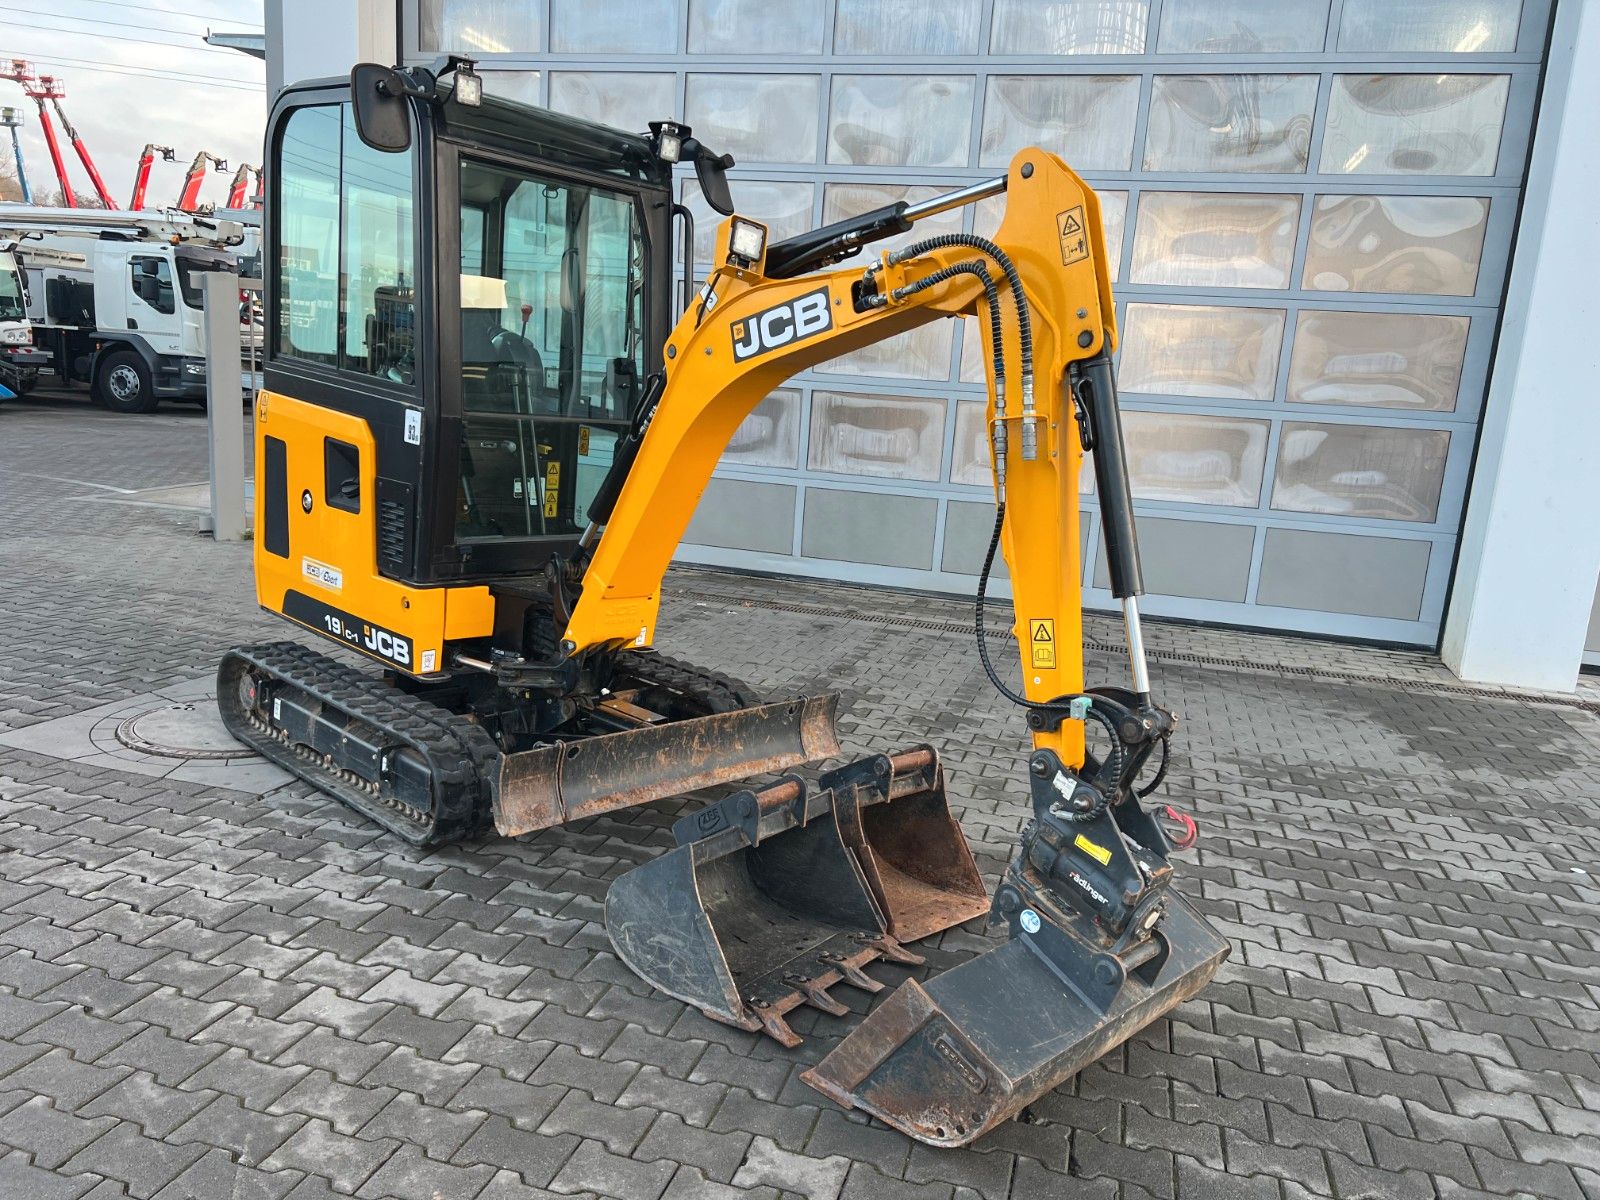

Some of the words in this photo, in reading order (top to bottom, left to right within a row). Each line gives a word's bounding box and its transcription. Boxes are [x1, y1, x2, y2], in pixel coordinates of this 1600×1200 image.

[735, 292, 830, 358] JCB
[324, 614, 341, 634] 19
[364, 626, 410, 664] JCB
[1069, 871, 1109, 904] rädlinger
